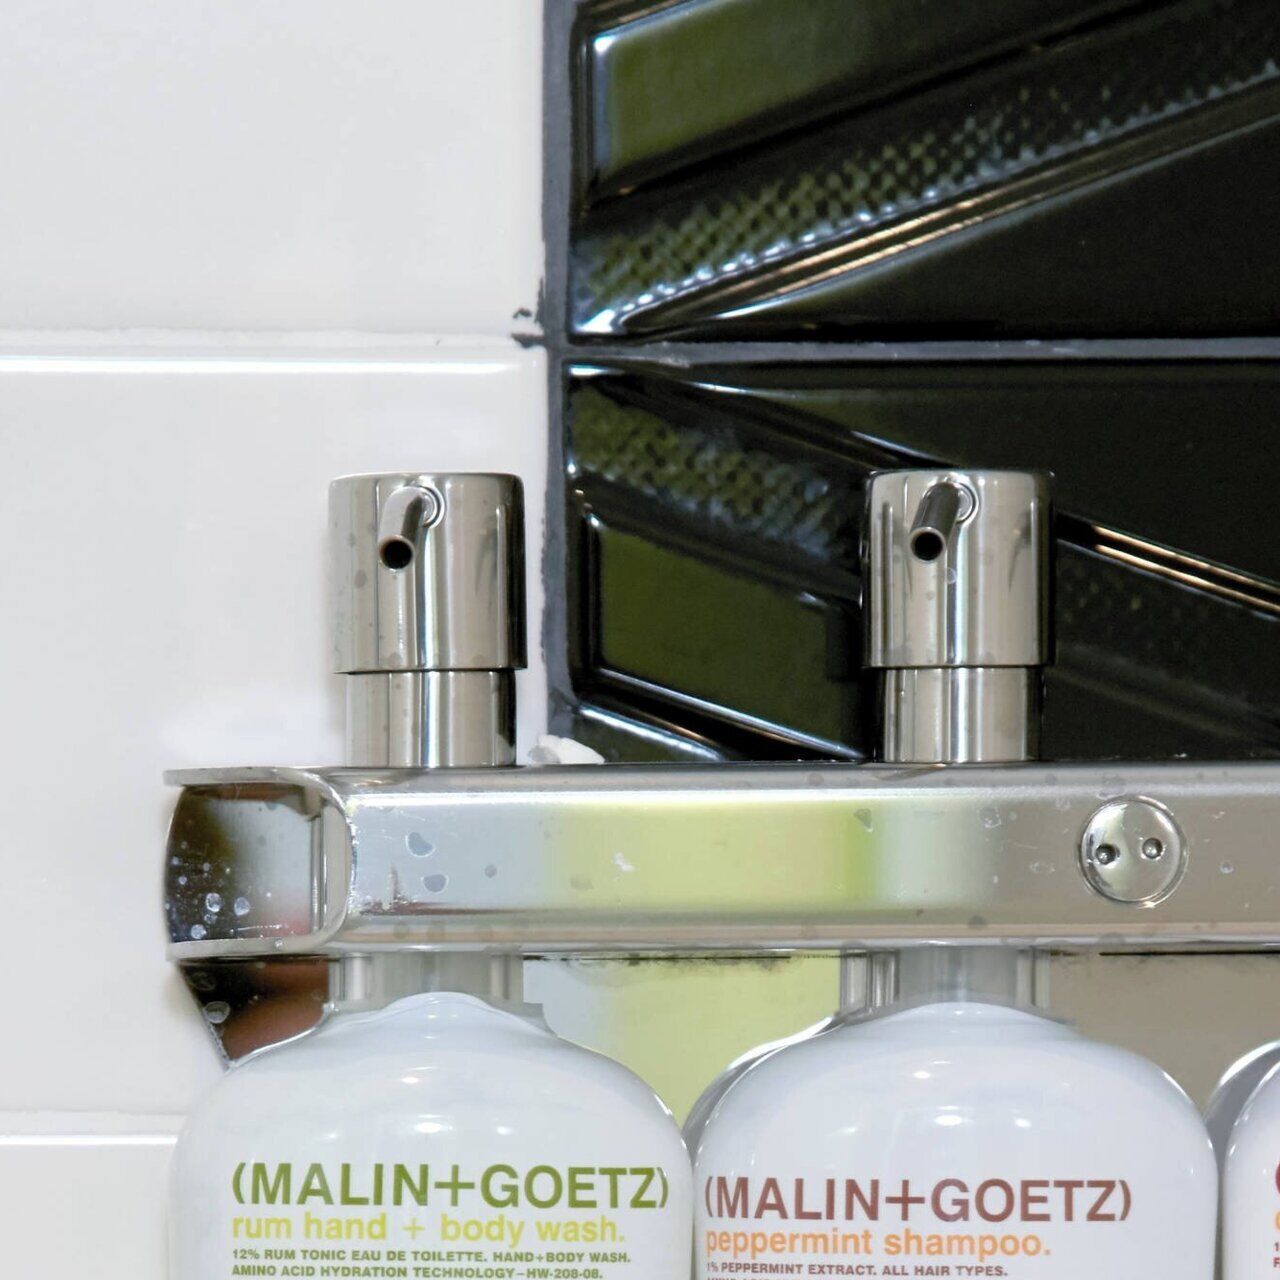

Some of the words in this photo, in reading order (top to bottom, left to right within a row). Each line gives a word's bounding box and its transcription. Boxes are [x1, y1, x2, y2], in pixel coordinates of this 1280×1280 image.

[232, 1162, 669, 1209] (MALIN+GOETZ)
[705, 1176, 1132, 1222] (MALIN+GOETZ)
[231, 1215, 292, 1240] rum
[304, 1212, 387, 1240] hand
[440, 1213, 525, 1248] body
[537, 1216, 625, 1243] wash.
[706, 1227, 872, 1259] peppermint
[883, 1228, 1051, 1263] shampoo.
[232, 1249, 260, 1261] 12%
[264, 1250, 296, 1261] RUM
[301, 1250, 346, 1262] TONIC
[351, 1251, 381, 1262] EAU
[387, 1251, 406, 1262] DE
[412, 1251, 488, 1263] TOILETTE.
[589, 1252, 631, 1263] WASH.
[232, 1265, 277, 1277] AMINO
[281, 1265, 315, 1277] ACID
[320, 1266, 407, 1278] HYDRATION
[721, 1262, 803, 1275] PEPPERMINT
[808, 1264, 877, 1276] EXTRACT.
[882, 1265, 909, 1276] ALL
[914, 1265, 950, 1276] HAIR
[956, 1265, 1008, 1276] TYPES.
